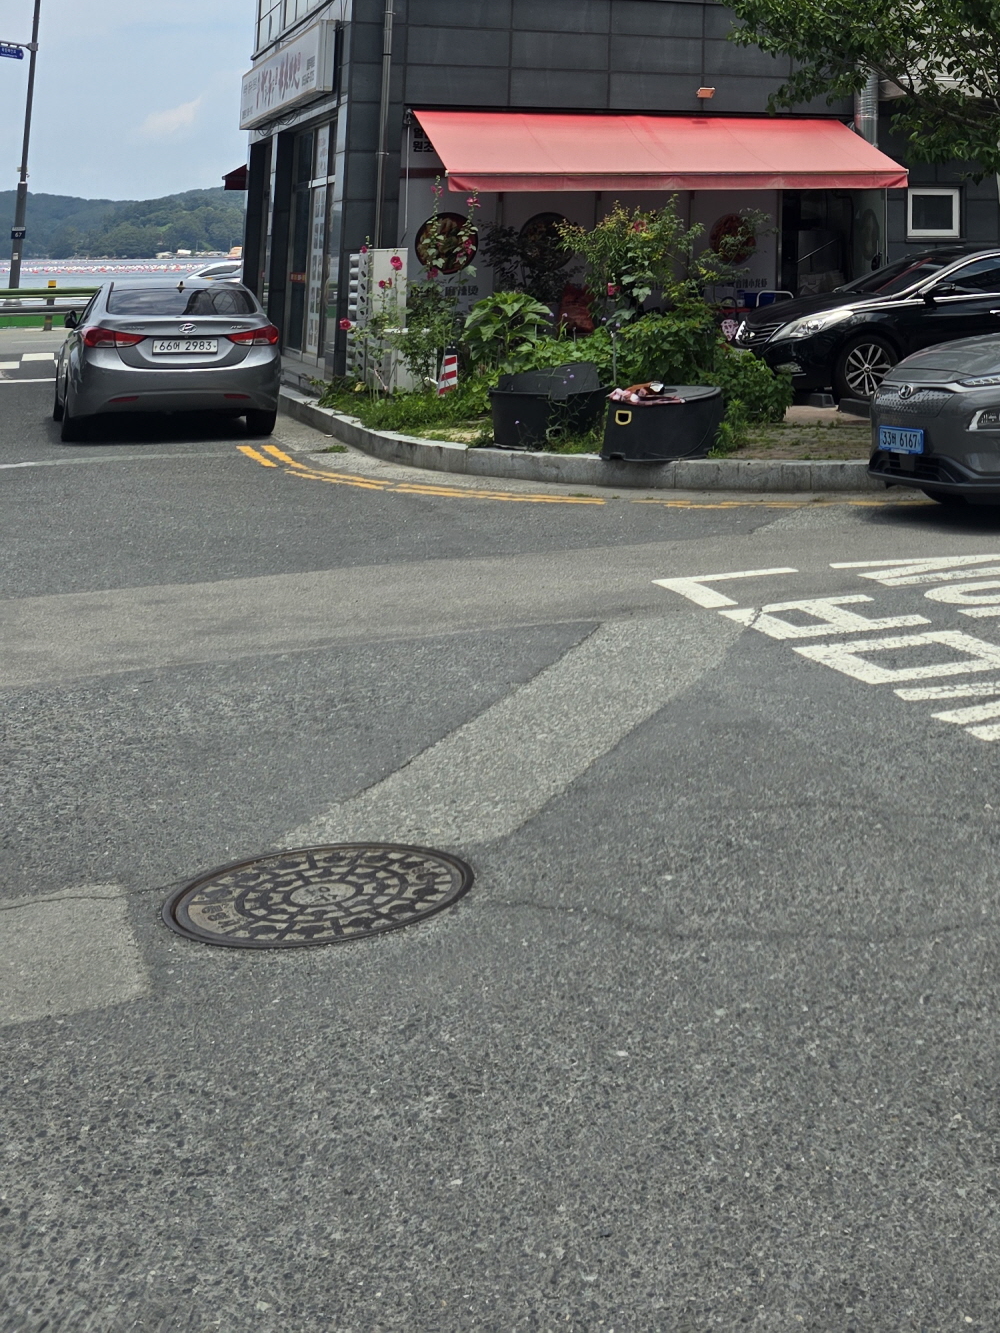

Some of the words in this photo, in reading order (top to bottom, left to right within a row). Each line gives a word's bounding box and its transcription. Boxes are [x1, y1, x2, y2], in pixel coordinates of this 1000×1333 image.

[159, 341, 180, 351] 66어
[185, 341, 212, 351] 2983
[899, 432, 918, 448] 6167
